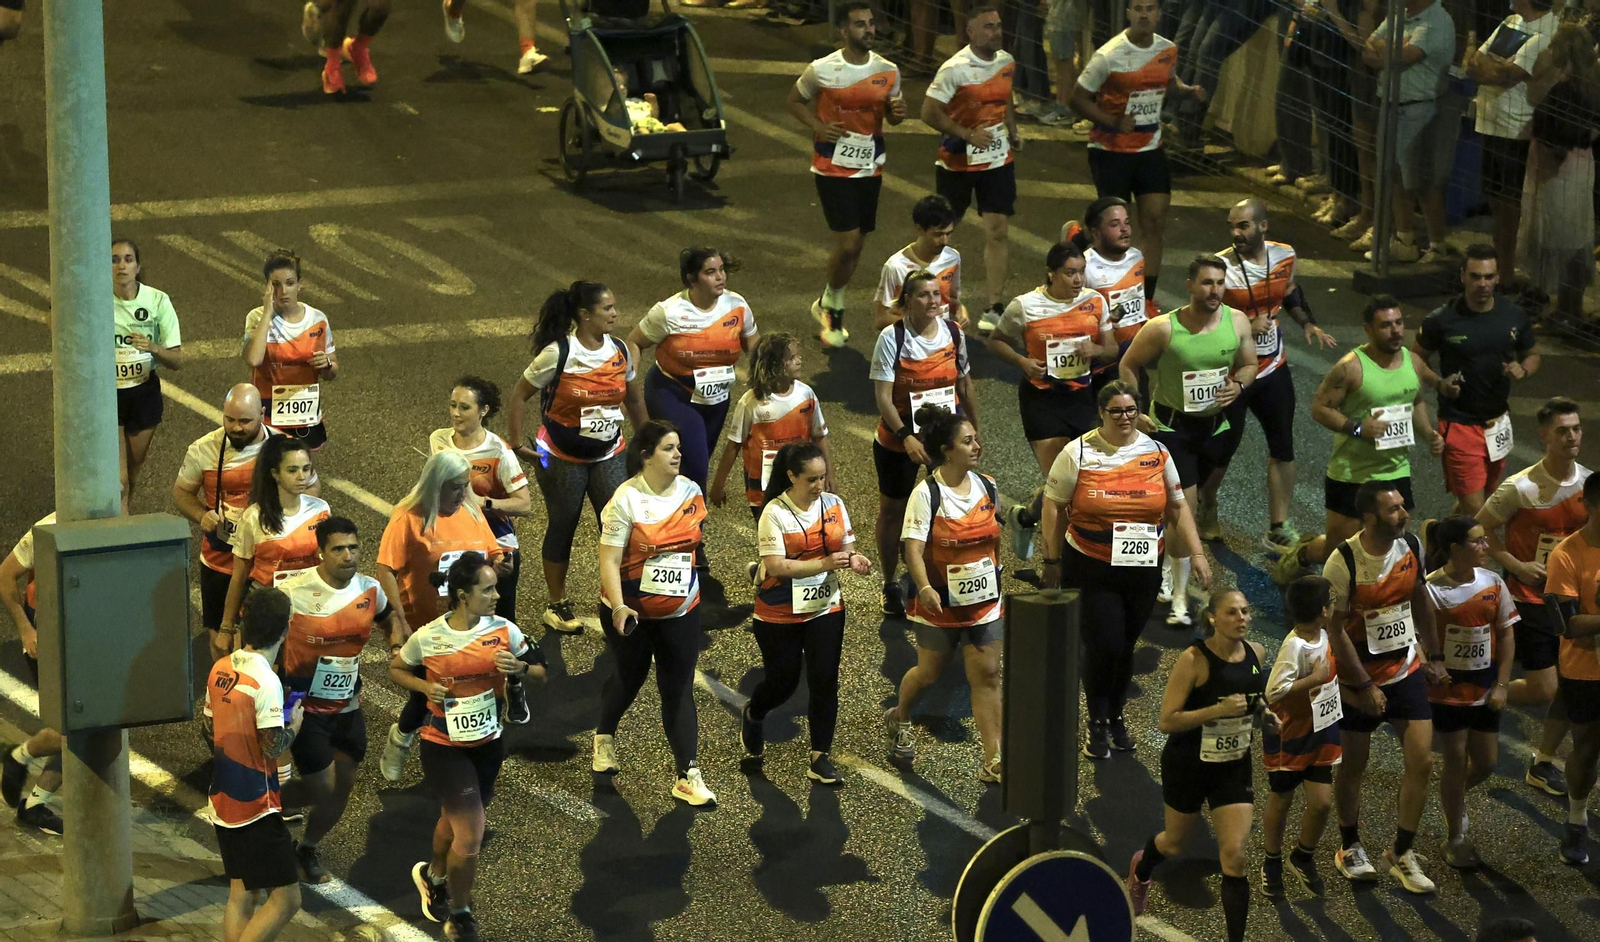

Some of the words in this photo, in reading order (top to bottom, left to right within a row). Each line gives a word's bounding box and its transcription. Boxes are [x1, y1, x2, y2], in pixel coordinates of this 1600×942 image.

[840, 145, 873, 159] 22156
[1124, 299, 1141, 315] 320
[277, 400, 314, 414] 21907
[1383, 421, 1409, 438] 0381
[1088, 490, 1106, 498] 37
[1121, 541, 1150, 555] 2269
[652, 569, 683, 585] 2304
[803, 585, 831, 601] 2268
[958, 577, 988, 595] 2290
[1377, 621, 1406, 641] 2289
[1454, 643, 1485, 659] 2286
[215, 676, 234, 692] KH7
[323, 674, 352, 688] 8220
[1320, 696, 1338, 718] 2295
[453, 709, 491, 730] 10524
[1216, 736, 1239, 751] 656
